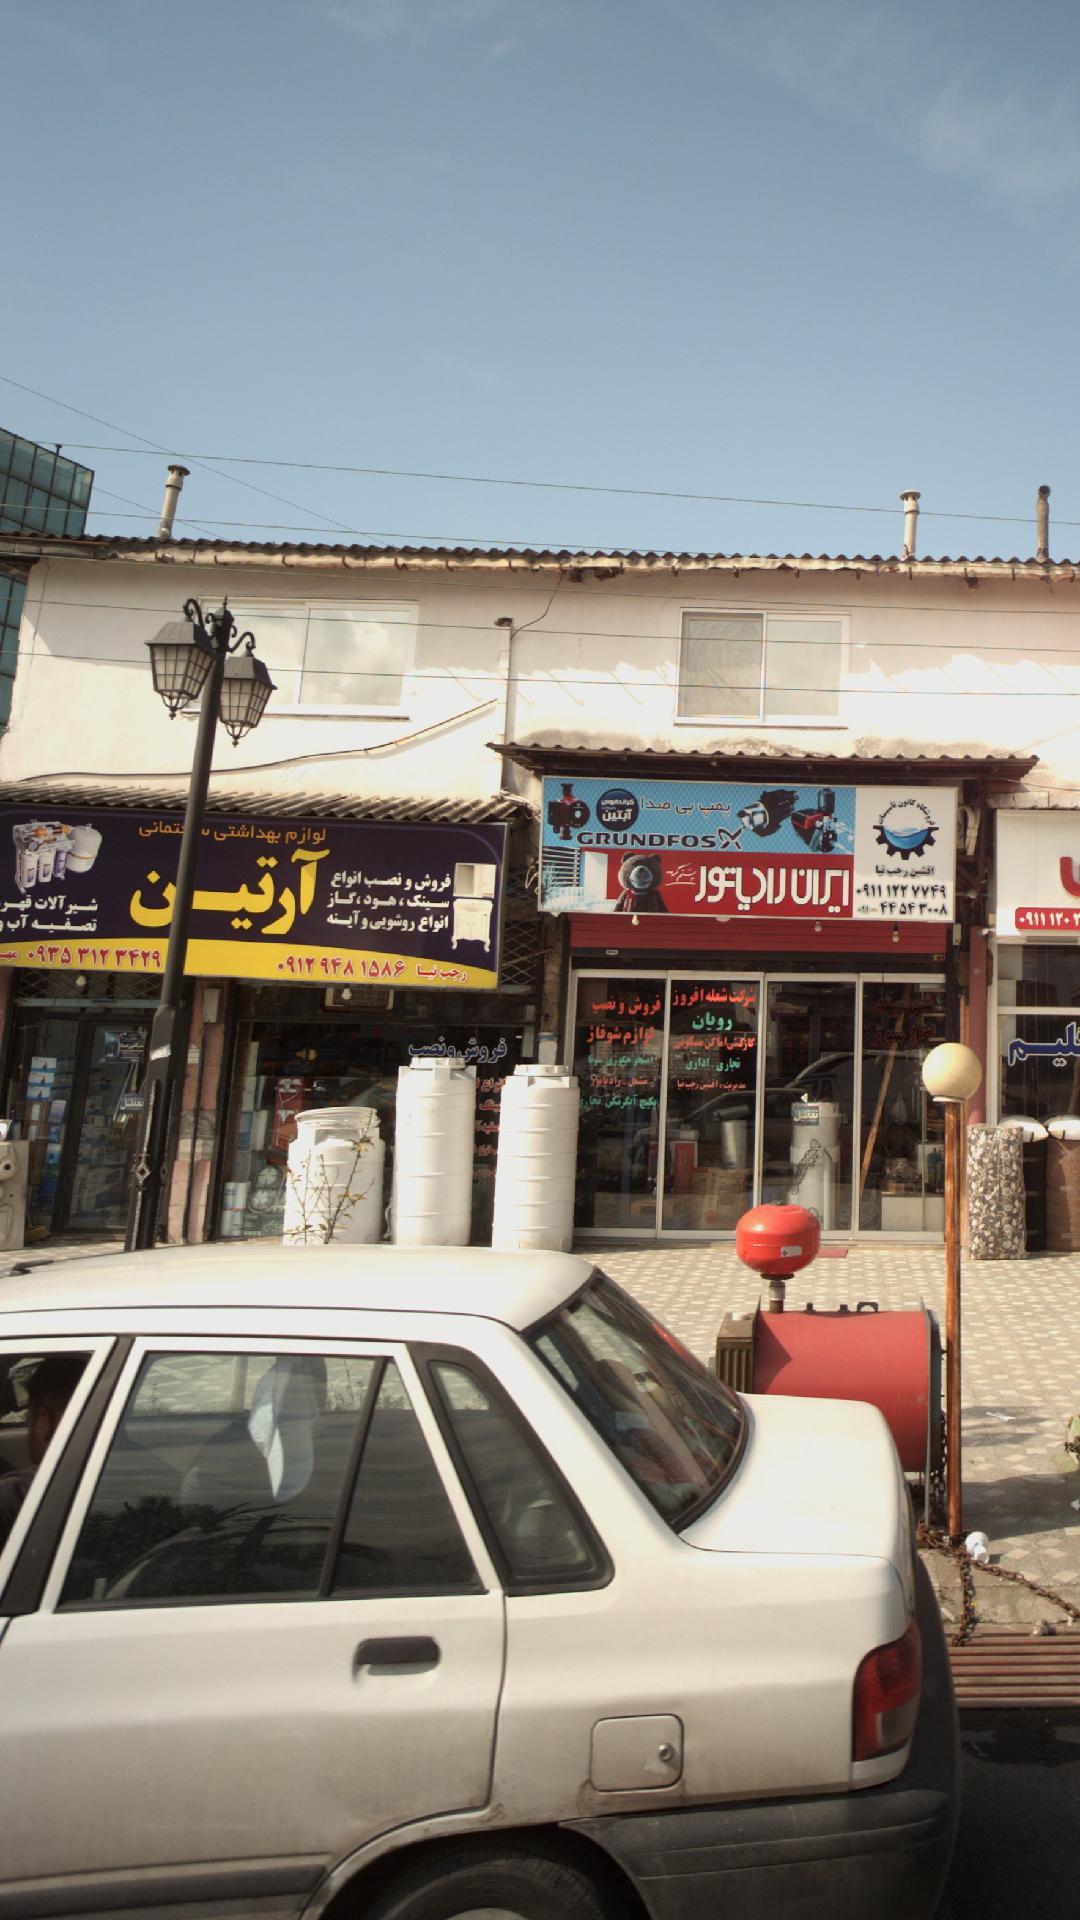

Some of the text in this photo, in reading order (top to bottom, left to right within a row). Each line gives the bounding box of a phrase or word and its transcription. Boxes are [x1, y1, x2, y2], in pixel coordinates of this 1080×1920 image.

[640, 794, 732, 818] پمپ بی صدا
[213, 823, 282, 846] بهداشتی
[285, 827, 327, 845] لوازم
[576, 832, 717, 848] GRUNDFOS
[330, 870, 452, 892] فروش و نصب انواع
[875, 865, 935, 878] افشین رجب نیا
[129, 848, 331, 934] آرتین
[694, 865, 850, 913] ایران رادیاتور
[857, 883, 882, 897] ۰۹۱۱
[912, 883, 947, 899] ۷۷۴۹
[0, 894, 98, 915] شیر آلات قهر
[6, 914, 29, 932] آب
[31, 917, 98, 933] تصفیه
[326, 910, 449, 933] انواع روشویی و آینه
[1019, 911, 1047, 927] ۰۹۱۱
[28, 944, 72, 966] ۰۹۳۵
[77, 947, 110, 966] ۳۱۲
[115, 948, 162, 969] ۳۴۲۹
[277, 955, 406, 978] ۰۹۱۲ ۹۴۸ ۱۵۸۶
[415, 964, 469, 983] رجب نیا
[592, 994, 661, 1016] فروش و نصب
[672, 985, 757, 1008] شرکت شعله افروز
[691, 1011, 734, 1031] رویان
[623, 1024, 655, 1045] لوازم
[408, 1035, 446, 1057] نصب
[457, 1036, 508, 1064] فروش
[685, 1056, 742, 1073] تجاری اداری
